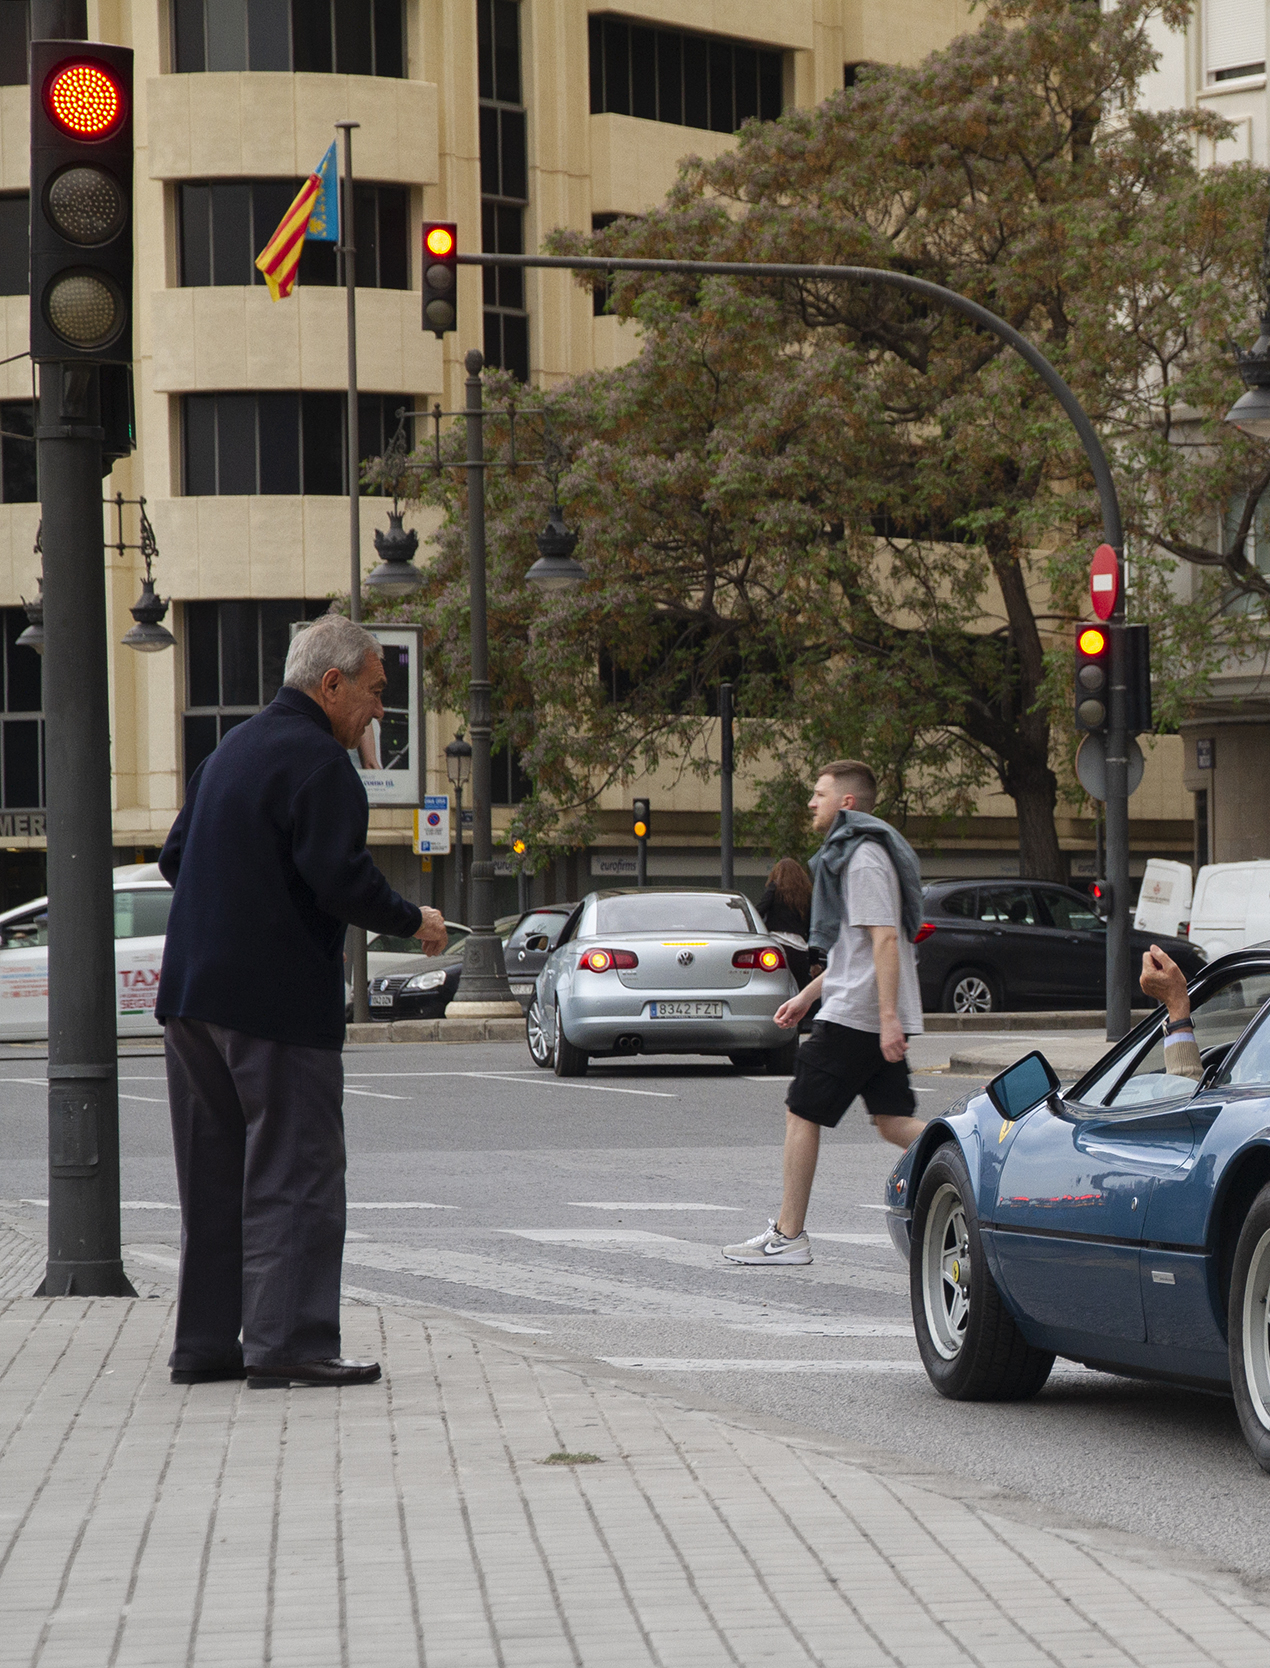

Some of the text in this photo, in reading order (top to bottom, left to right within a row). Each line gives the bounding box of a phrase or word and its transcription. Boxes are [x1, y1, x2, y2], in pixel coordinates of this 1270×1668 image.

[600, 858, 636, 873] eurofirms
[659, 1003, 719, 1015] 8342 FZT
